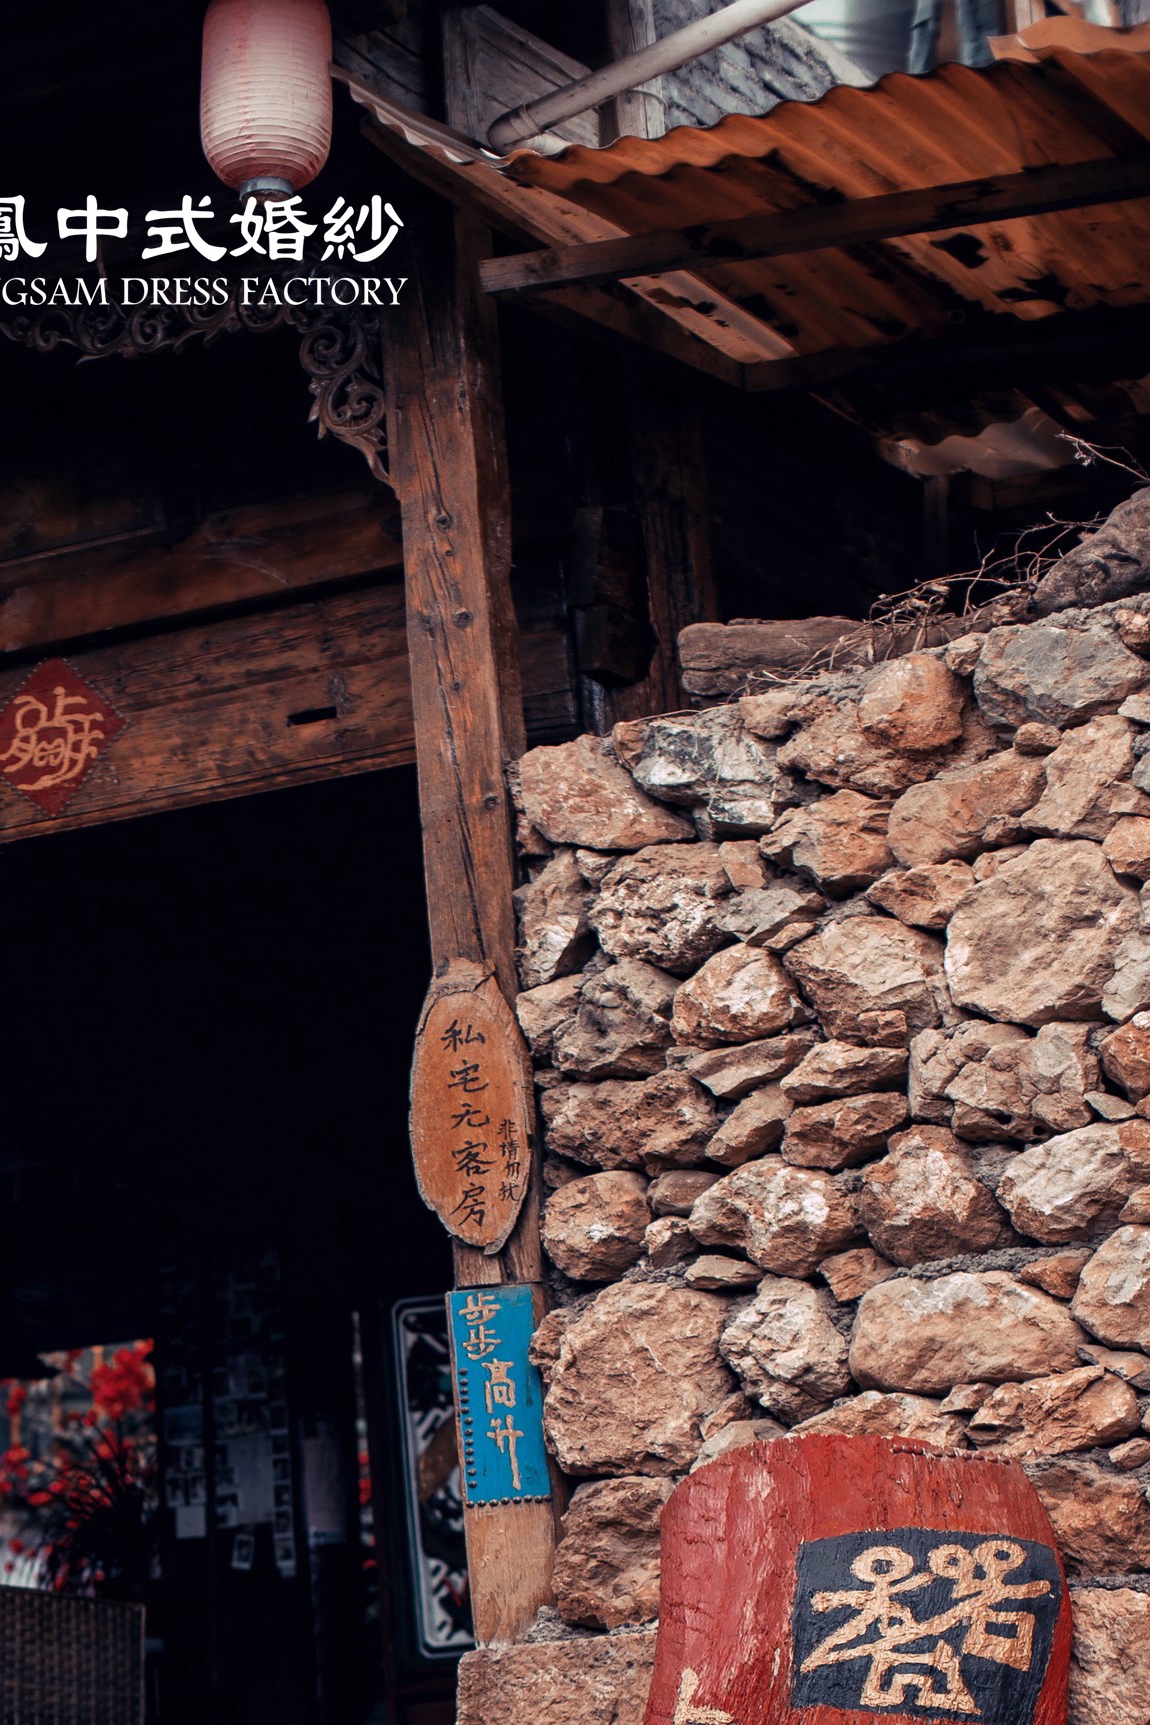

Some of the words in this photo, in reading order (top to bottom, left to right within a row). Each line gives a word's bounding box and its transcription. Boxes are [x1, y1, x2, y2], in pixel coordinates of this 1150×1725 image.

[440, 1018, 498, 1228] 私宅无客房
[497, 1118, 522, 1203] 非请勿扰
[458, 1291, 525, 1491] 步步高升
